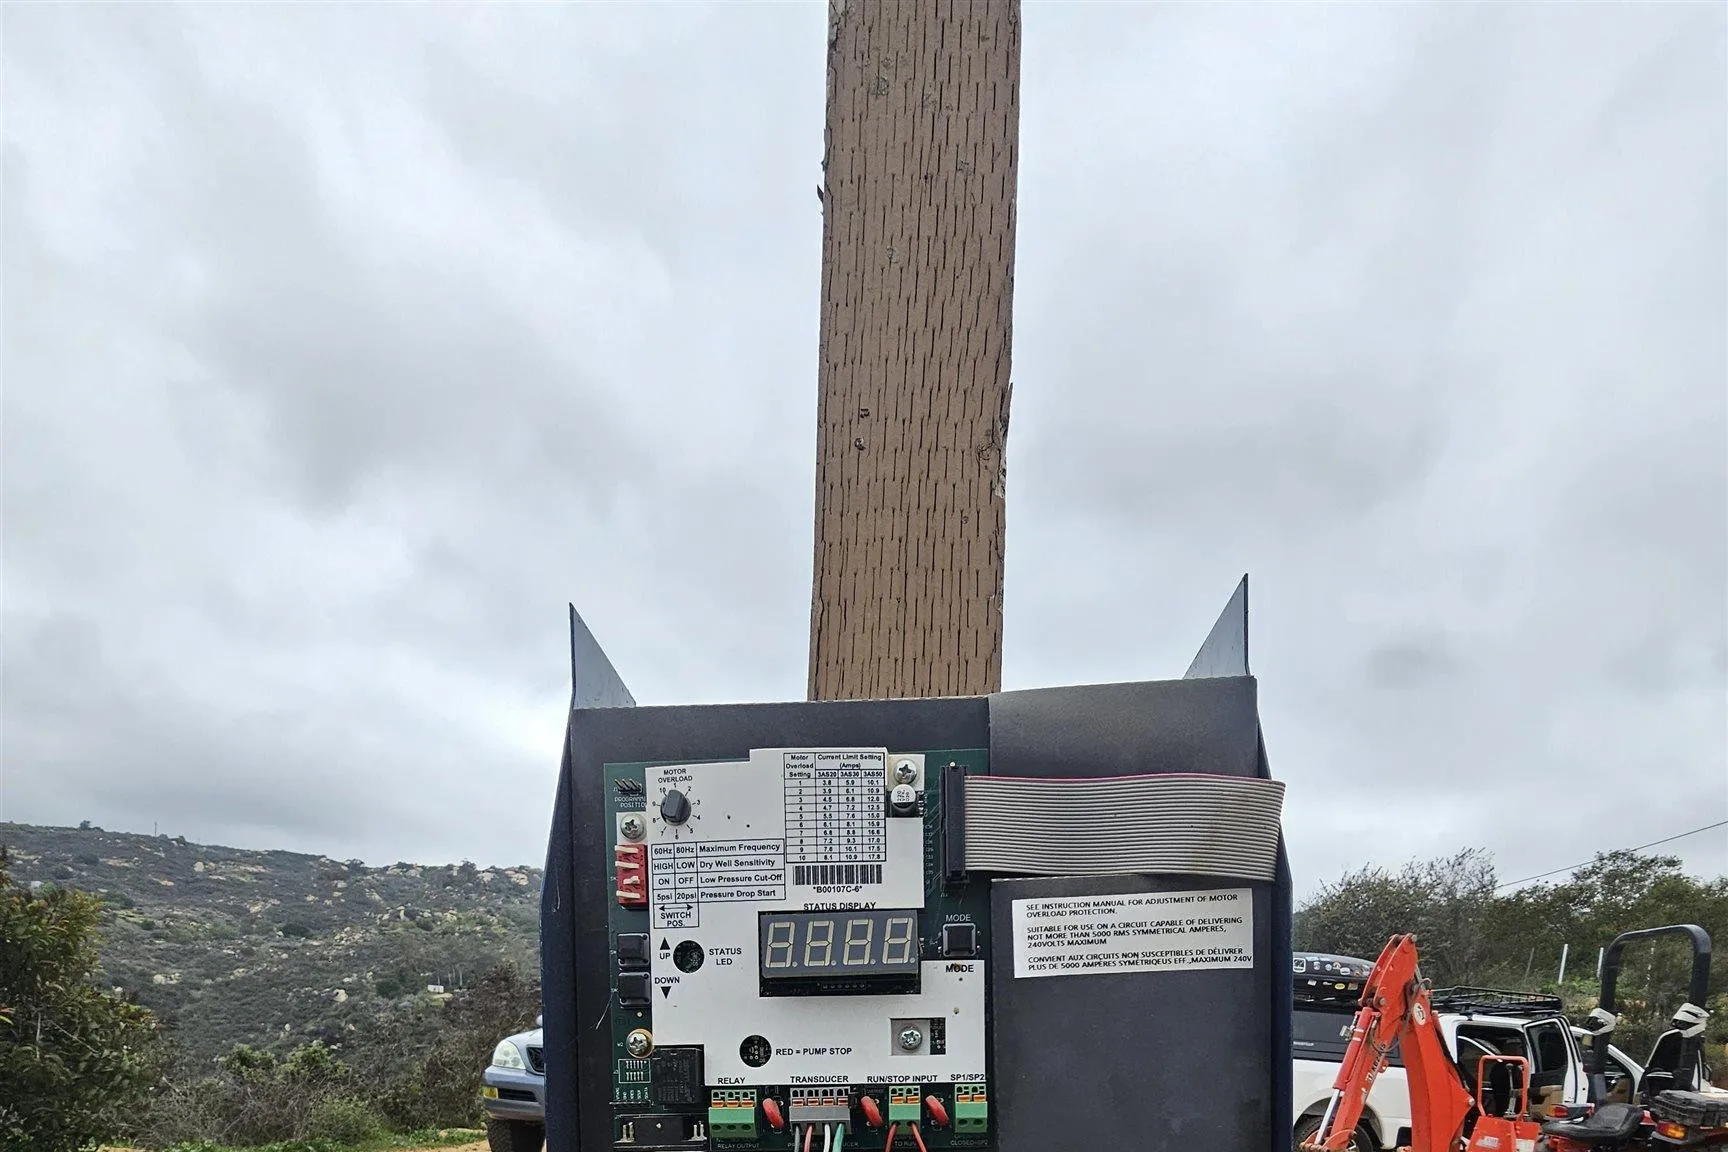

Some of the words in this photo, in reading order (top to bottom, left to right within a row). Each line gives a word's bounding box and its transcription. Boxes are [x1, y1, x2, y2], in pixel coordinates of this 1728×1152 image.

[676, 846, 695, 854] 80Hz
[699, 845, 737, 853] Maximum
[738, 843, 781, 851] Frequency
[700, 861, 713, 869] Dry
[715, 859, 732, 867] Well
[734, 858, 776, 868] Sensitivity
[700, 876, 717, 884] Low
[719, 875, 752, 883] Pressure
[657, 893, 673, 902] 5psi
[676, 892, 697, 901] 20psi
[701, 891, 735, 899] Pressure
[737, 890, 756, 898] Drop
[758, 889, 776, 897] Start
[804, 902, 837, 910] STATUS
[840, 901, 876, 910] DISPLAY
[1042, 901, 1091, 910] INSTRUCTION
[1092, 900, 1126, 908] MANUAL
[1128, 898, 1143, 906] FOR
[1145, 896, 1195, 905] ADJUSTMENT
[1209, 894, 1238, 902] MOTOR
[660, 911, 692, 920] SWITCH
[1069, 908, 1118, 916] PROTECTION.
[946, 914, 971, 922] MODE
[667, 919, 685, 927] POS.
[1046, 932, 1068, 940] MORE
[1132, 927, 1187, 936] SYMMETRICAL
[1189, 925, 1227, 933] AMPERES,
[1027, 940, 1066, 948] 240VOLTS
[1067, 938, 1107, 946] MAXIMUM
[659, 952, 671, 960] UP
[709, 948, 742, 956] STATUS
[716, 958, 733, 966] LED
[946, 965, 974, 973] MODE
[775, 1048, 794, 1056] RED
[829, 1047, 852, 1055] STOP
[867, 1075, 911, 1083] RUN/STOP
